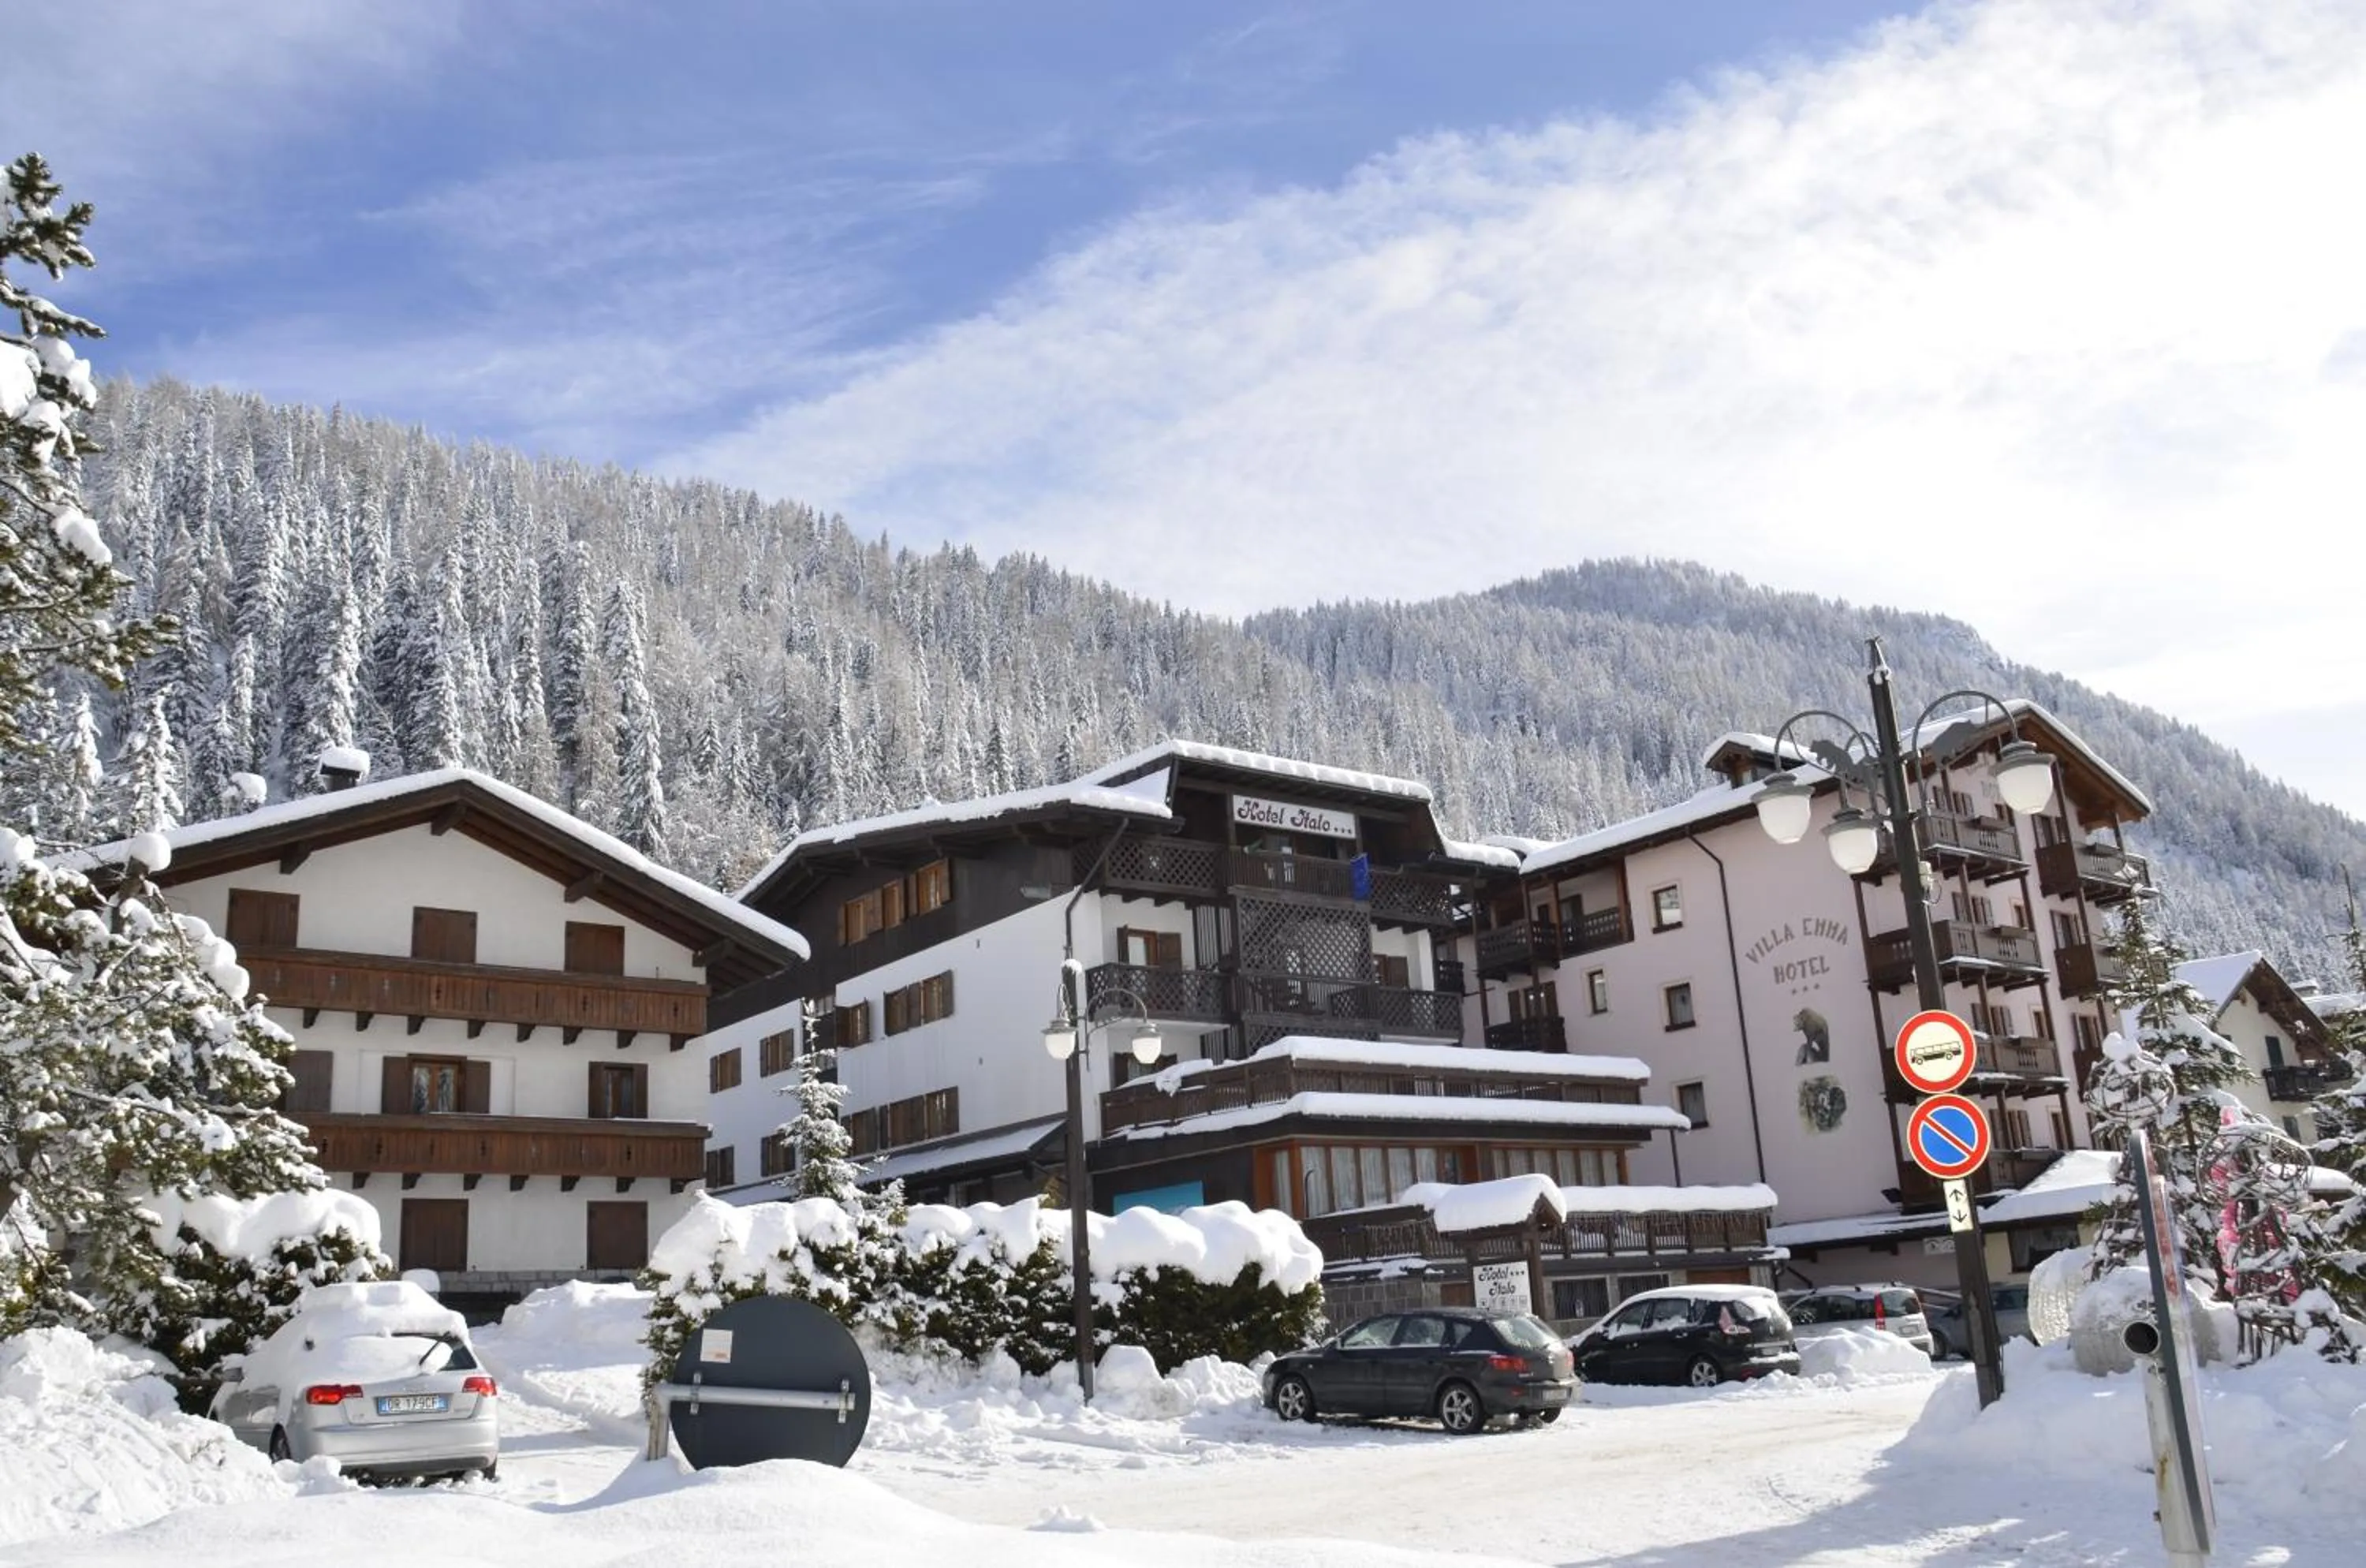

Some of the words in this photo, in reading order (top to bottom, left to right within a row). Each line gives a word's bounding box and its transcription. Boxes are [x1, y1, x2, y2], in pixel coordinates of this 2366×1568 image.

[1237, 799, 1284, 825] Hotel
[1290, 808, 1330, 832] Italo
[1745, 922, 1796, 964] VILLA
[1802, 917, 1849, 946] EMMA
[1773, 954, 1830, 985] HOTEL
[1478, 1266, 1509, 1282] Hotel
[1488, 1280, 1517, 1296] Italo
